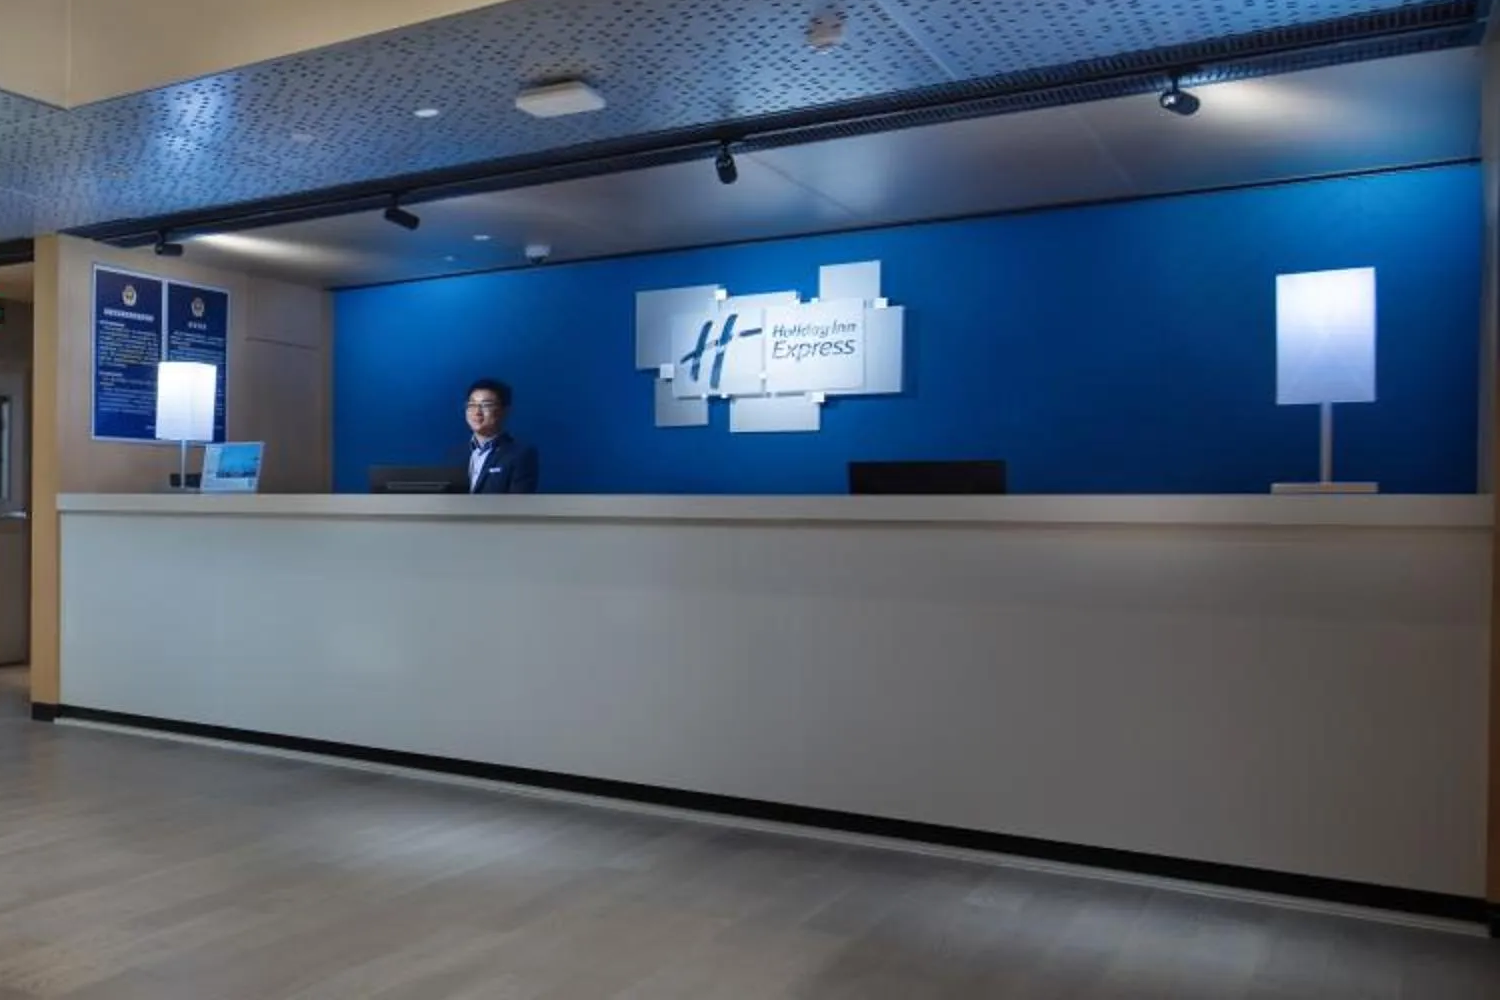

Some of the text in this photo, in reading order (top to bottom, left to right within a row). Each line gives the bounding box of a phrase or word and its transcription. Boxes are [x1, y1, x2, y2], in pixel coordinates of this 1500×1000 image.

[772, 319, 857, 339] Holiday Inn
[772, 339, 856, 361] Express
